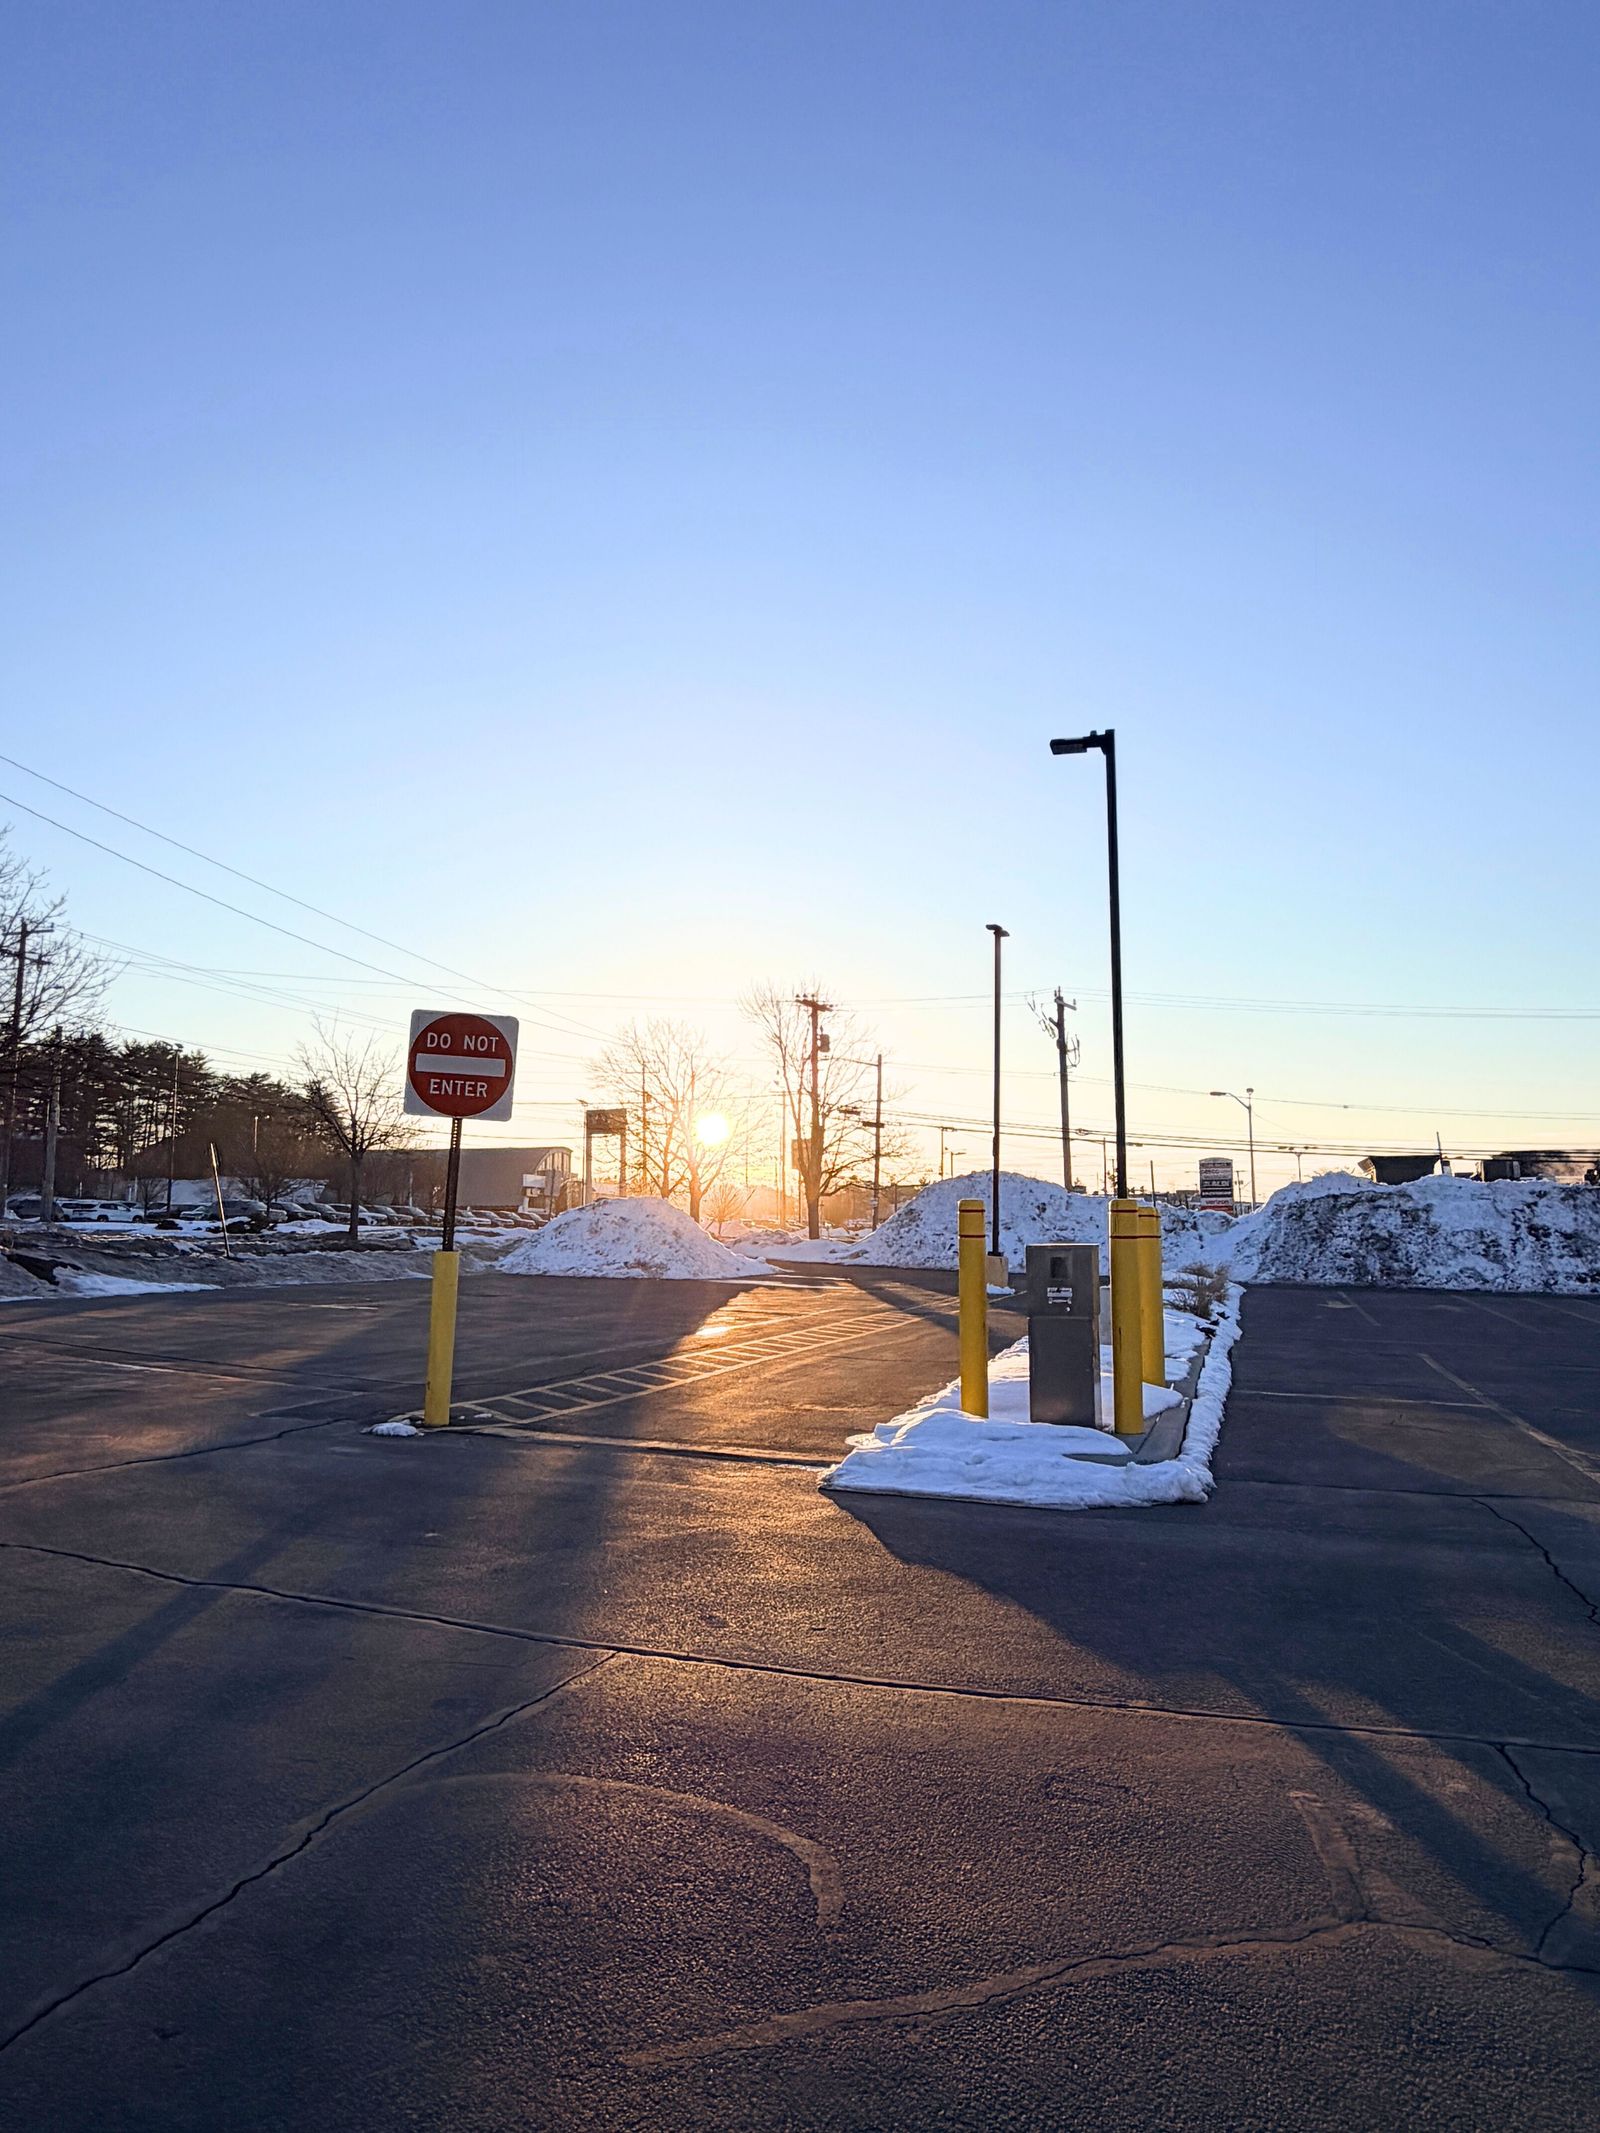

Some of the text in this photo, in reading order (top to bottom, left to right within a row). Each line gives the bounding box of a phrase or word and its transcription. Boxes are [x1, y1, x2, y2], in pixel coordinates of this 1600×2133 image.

[427, 1032, 499, 1053] DO NOT
[429, 1078, 488, 1098] ENTER
